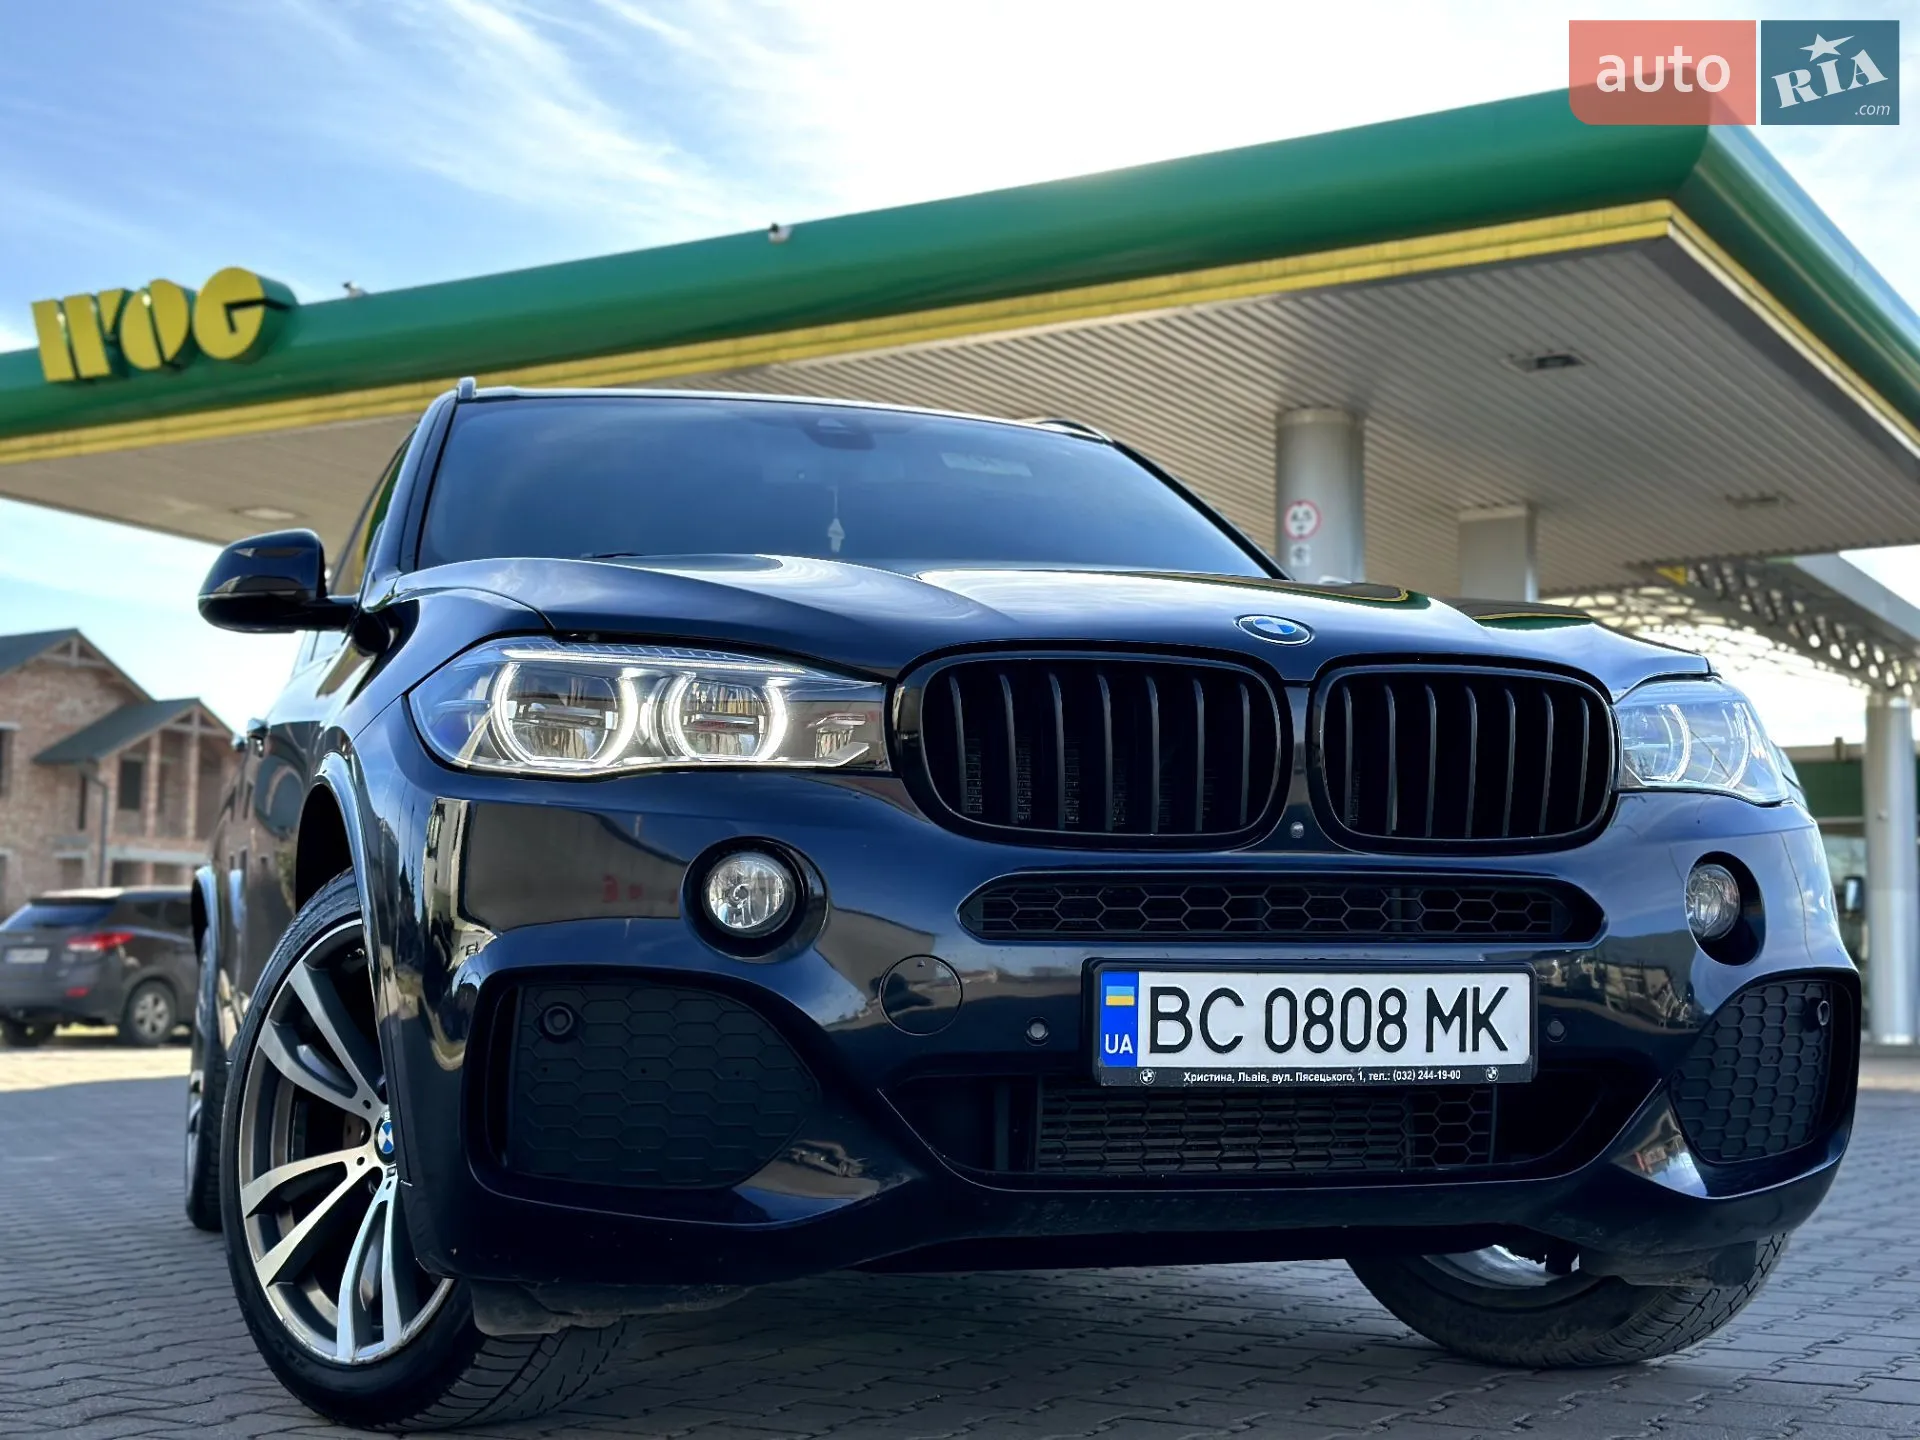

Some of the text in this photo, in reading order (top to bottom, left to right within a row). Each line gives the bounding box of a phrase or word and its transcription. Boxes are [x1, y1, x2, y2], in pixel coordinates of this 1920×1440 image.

[1149, 986, 1510, 1054] BC 0808 MK
[1104, 1034, 1134, 1054] UA
[1183, 1072, 1235, 1083] Христина,
[1237, 1072, 1270, 1083] Львів,
[1272, 1073, 1293, 1083] вул.
[1295, 1071, 1355, 1083] Пясецького,
[1368, 1072, 1391, 1082] тел.:
[1393, 1070, 1416, 1082] (032)
[1417, 1069, 1461, 1081] 244-19-00
